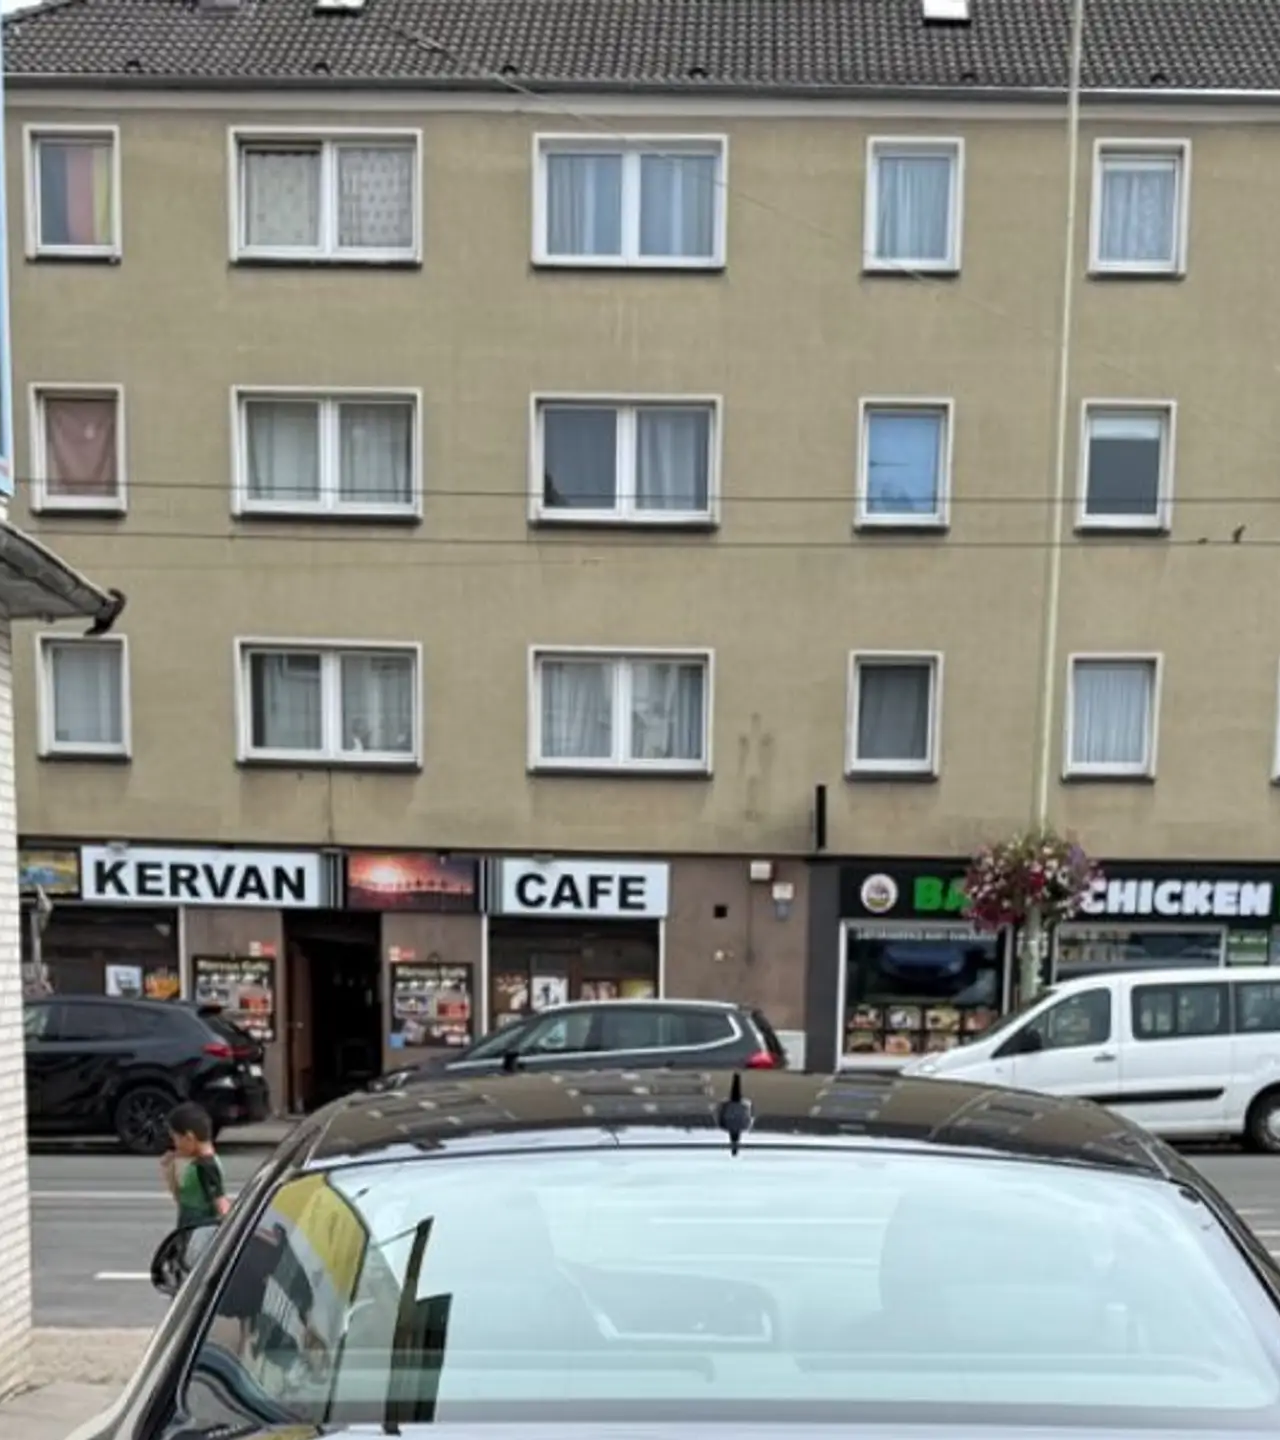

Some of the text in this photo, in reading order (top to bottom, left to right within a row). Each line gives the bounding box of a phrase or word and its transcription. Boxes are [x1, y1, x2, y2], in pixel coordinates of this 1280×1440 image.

[94, 859, 306, 901] KERVAN
[515, 872, 647, 911] CAFE
[1080, 878, 1272, 917] CHICKEN
